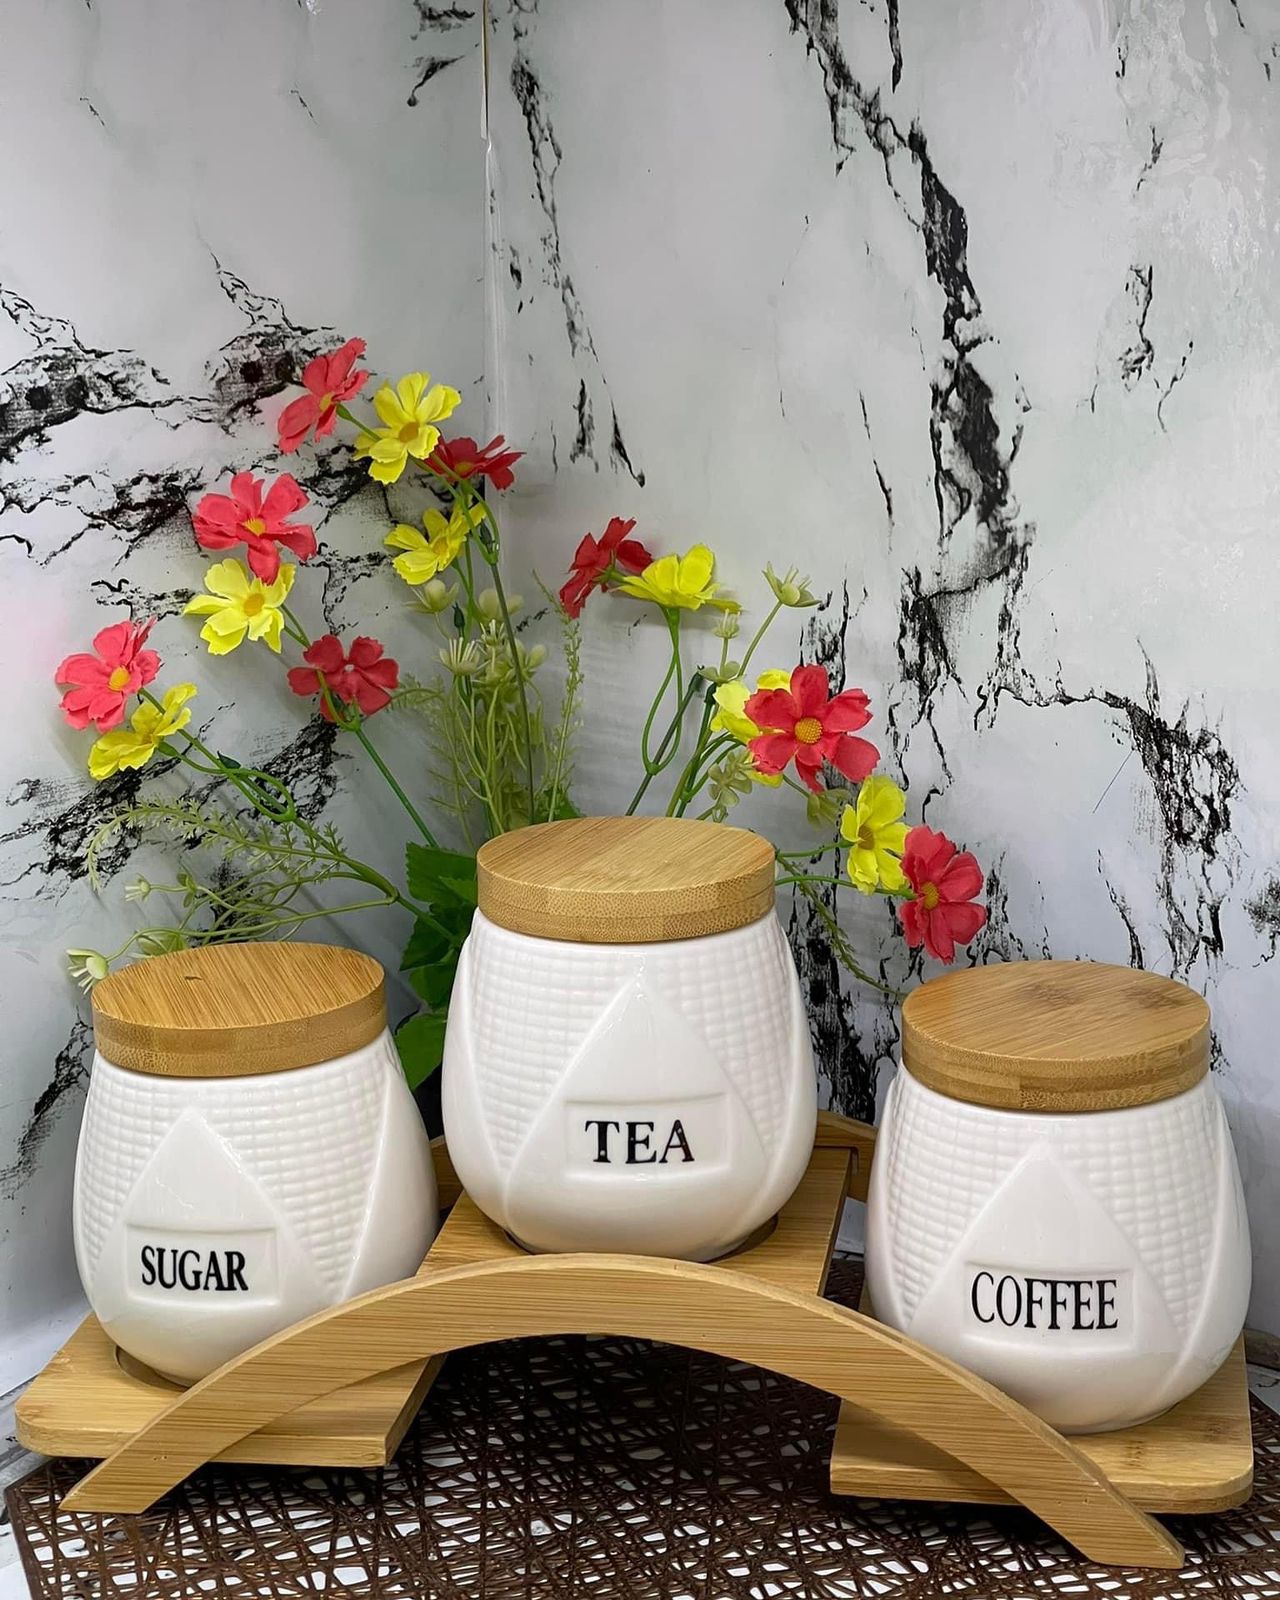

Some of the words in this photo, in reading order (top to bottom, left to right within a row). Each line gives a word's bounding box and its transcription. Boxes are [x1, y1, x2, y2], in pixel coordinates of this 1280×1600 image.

[584, 1119, 694, 1164] TEA
[141, 1245, 248, 1291] SUGAR
[971, 1271, 1118, 1329] COFFEE
